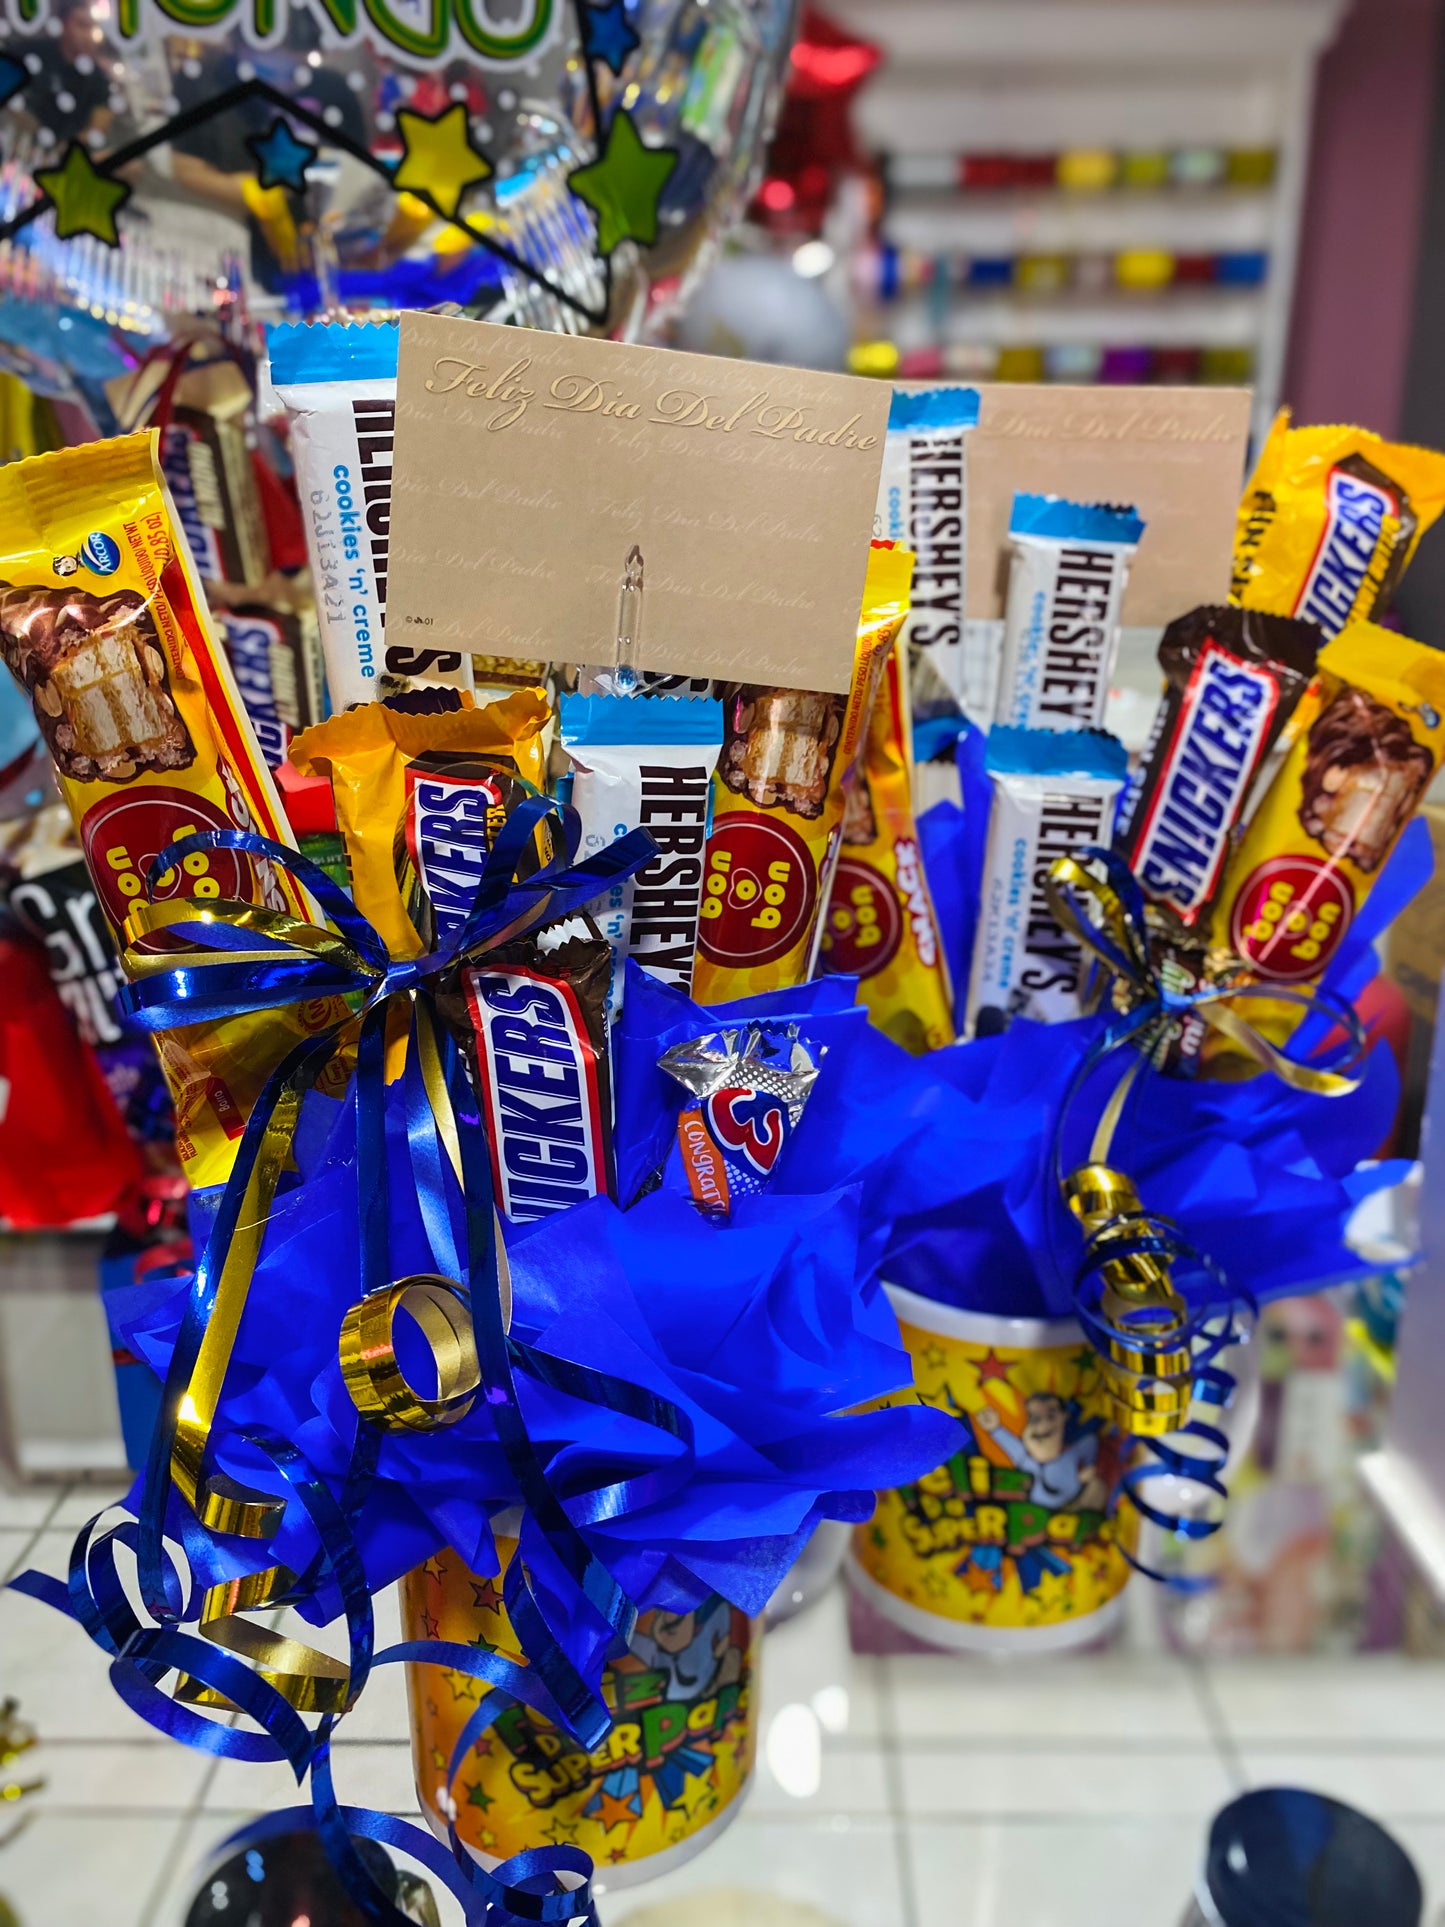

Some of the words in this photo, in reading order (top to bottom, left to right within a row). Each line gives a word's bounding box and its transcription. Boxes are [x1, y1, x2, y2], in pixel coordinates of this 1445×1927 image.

[424, 356, 537, 432] Feliz
[543, 374, 643, 420] Dia
[649, 390, 770, 434] Del
[751, 404, 878, 452] Padre
[90, 533, 114, 573] ARCOR
[123, 521, 137, 535] WT
[889, 486, 903, 538] cooki
[909, 437, 963, 645] HERSHEY'S
[332, 464, 363, 561] cookies
[352, 603, 376, 679] creme
[1305, 480, 1386, 652] ICKERS
[165, 628, 186, 681] CONTENIDO
[856, 664, 868, 685] PESO
[1039, 549, 1115, 722] HERSHEY
[226, 621, 286, 770] ICKERS
[1140, 659, 1265, 906] SNICKERS
[485, 803, 508, 852] TER
[692, 850, 732, 919] bon
[735, 879, 757, 901] o
[751, 860, 791, 929] bon
[851, 884, 883, 948] bon
[893, 838, 937, 966] SNACK
[1242, 880, 1295, 943] bon
[1289, 901, 1341, 961] bon
[477, 975, 590, 1222] ICKERS
[510, 1722, 643, 1806] SUPER
